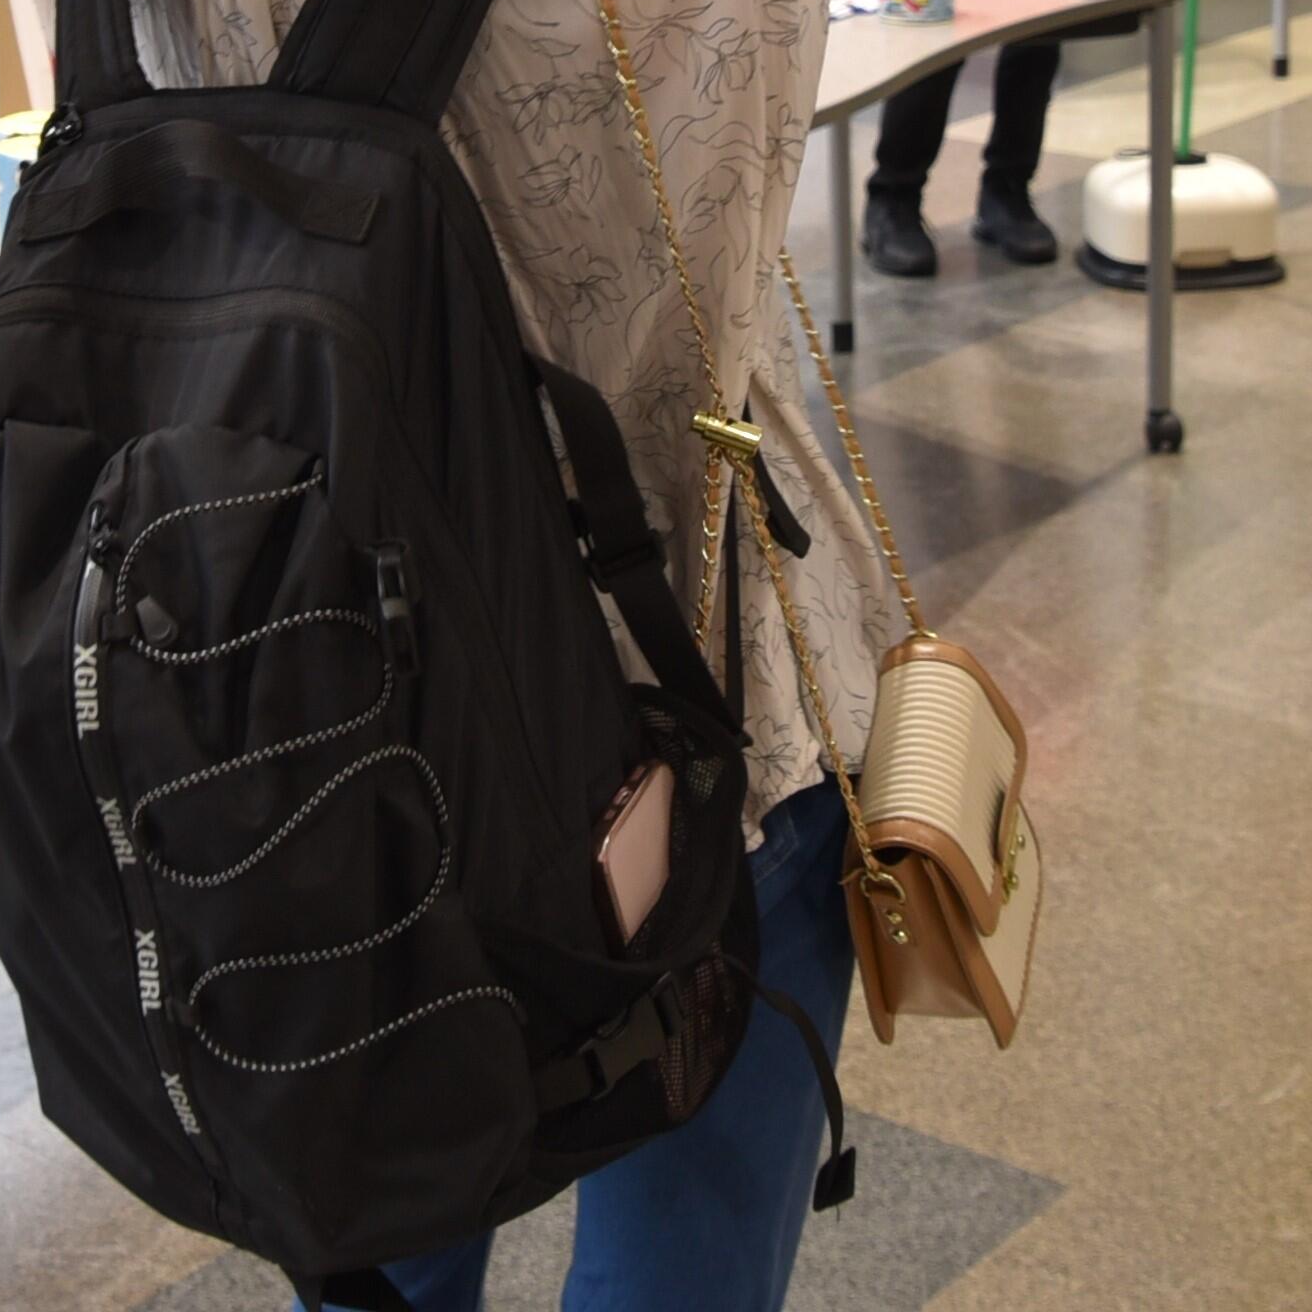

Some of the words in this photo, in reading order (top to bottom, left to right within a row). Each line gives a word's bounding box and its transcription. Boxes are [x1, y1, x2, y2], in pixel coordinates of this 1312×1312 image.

[72, 643, 100, 740] XGIRL
[96, 796, 137, 872] XGIRL
[134, 928, 163, 1017] XGIRL
[161, 1070, 201, 1137] XGIRL
